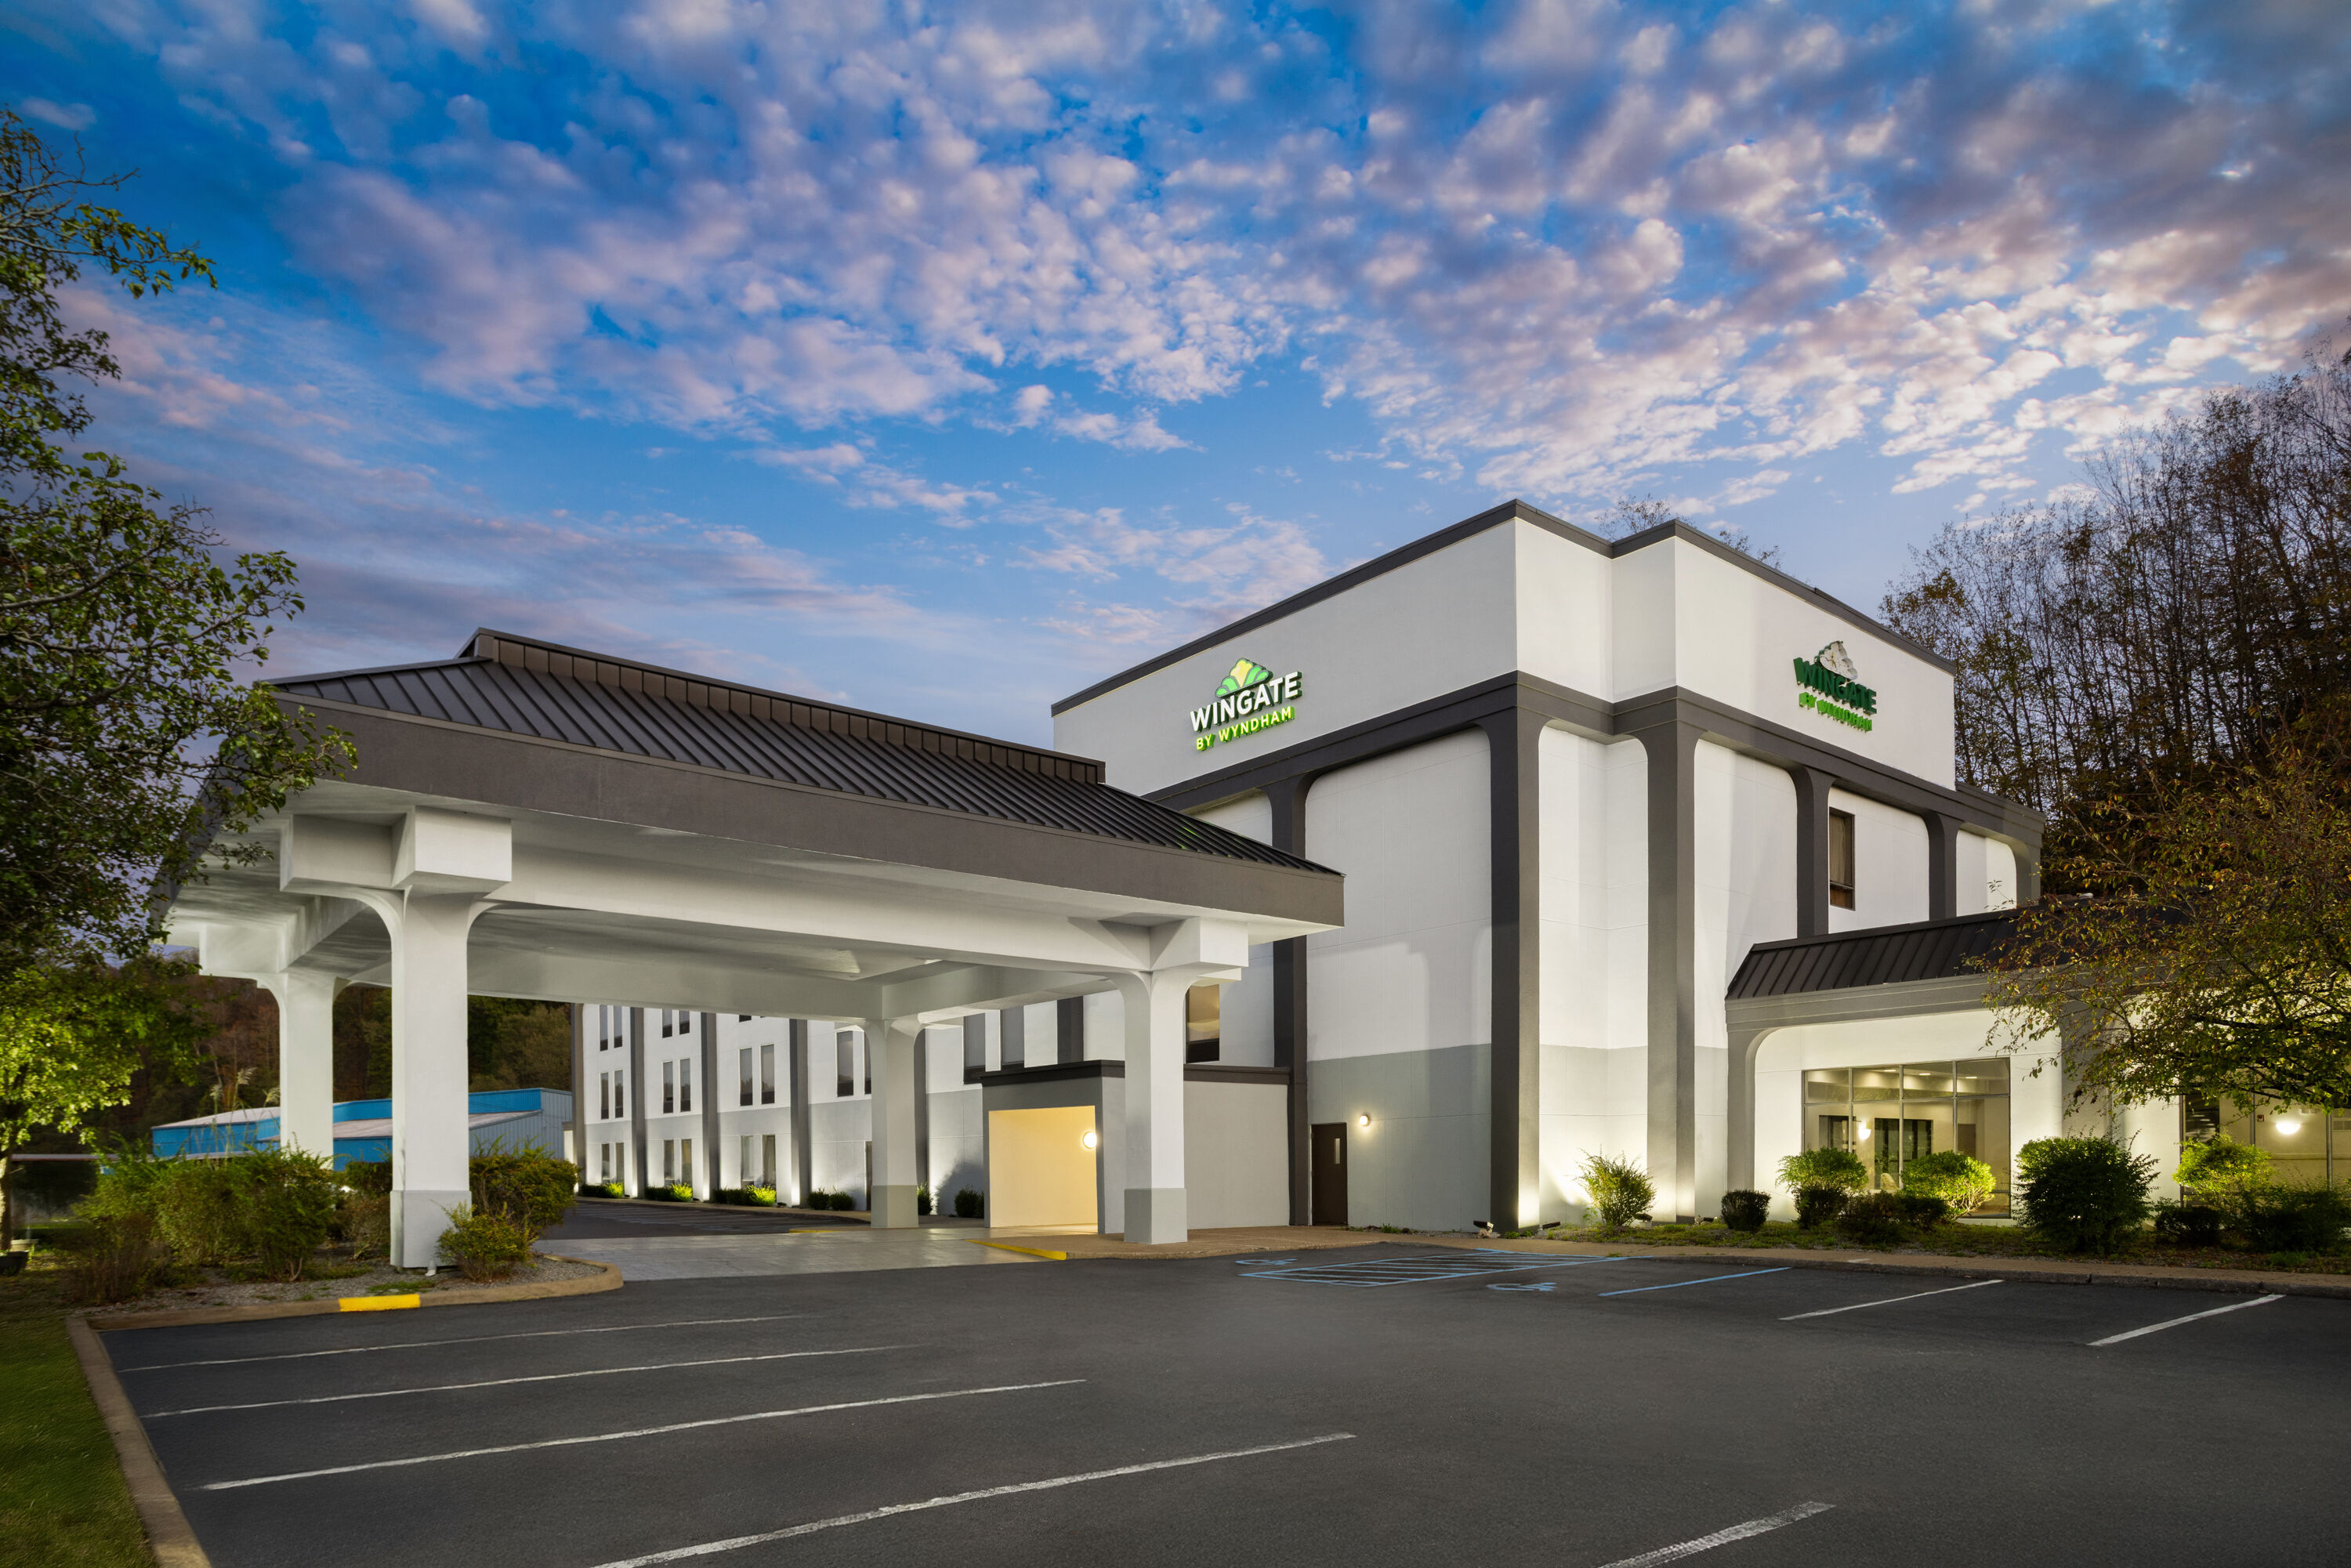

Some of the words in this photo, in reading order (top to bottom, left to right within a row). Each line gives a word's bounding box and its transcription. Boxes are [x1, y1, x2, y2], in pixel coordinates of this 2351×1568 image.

[1190, 671, 1302, 732] WINGATE
[1196, 733, 1215, 751] BY
[1219, 706, 1295, 742] WYNDHAM
